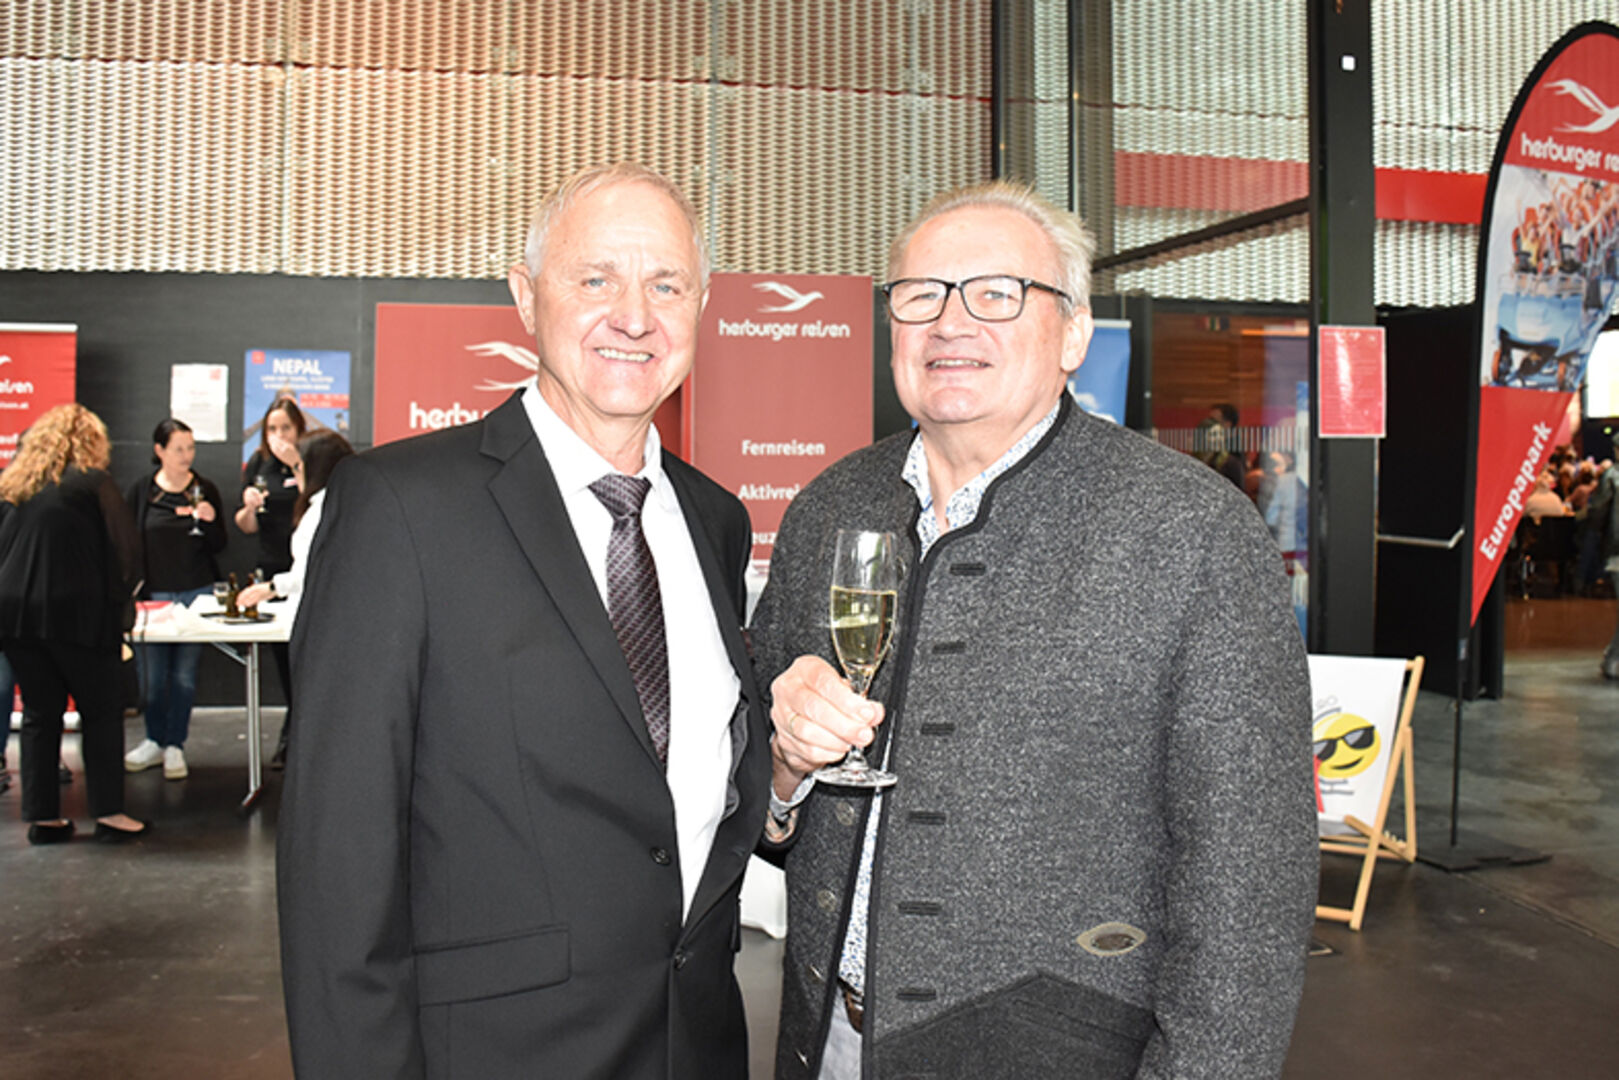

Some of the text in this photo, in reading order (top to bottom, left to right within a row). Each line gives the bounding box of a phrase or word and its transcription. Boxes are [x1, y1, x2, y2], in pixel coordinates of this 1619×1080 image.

[1521, 132, 1602, 171] herburger
[718, 319, 850, 341] herburger reisen
[273, 358, 323, 375] NEPAL
[741, 440, 826, 456] Fernreisen
[1479, 422, 1553, 561] Europapark
